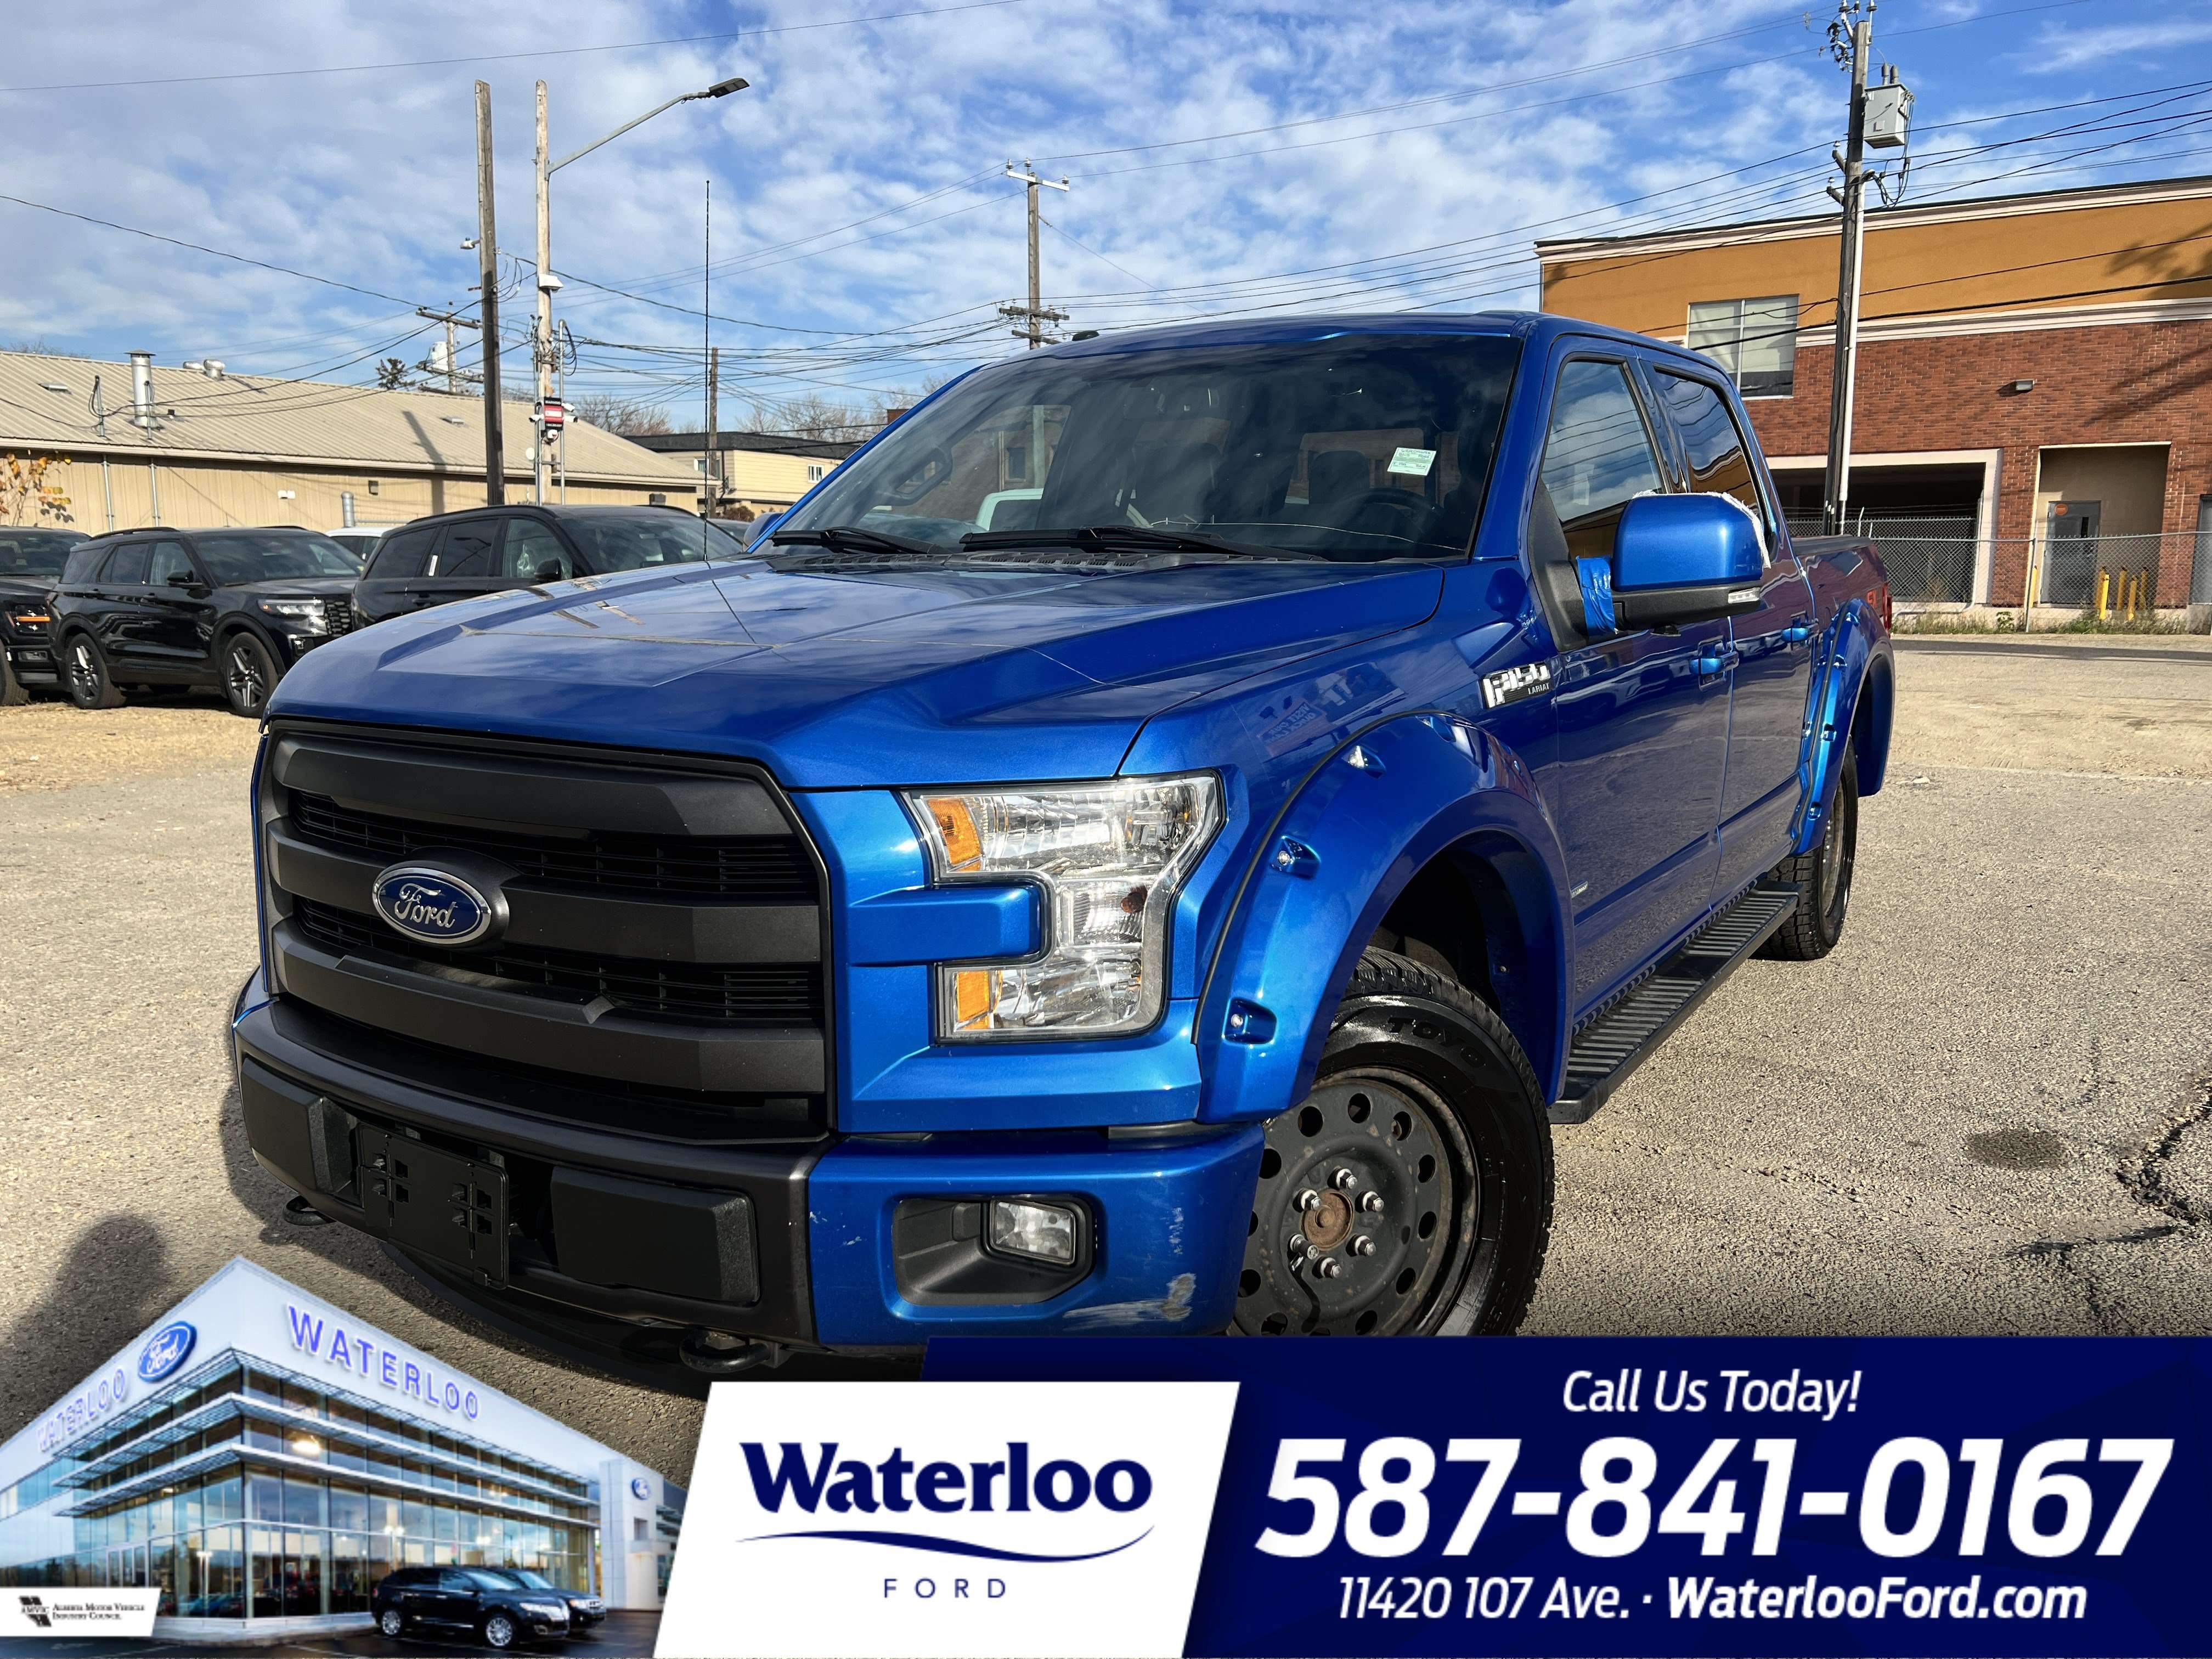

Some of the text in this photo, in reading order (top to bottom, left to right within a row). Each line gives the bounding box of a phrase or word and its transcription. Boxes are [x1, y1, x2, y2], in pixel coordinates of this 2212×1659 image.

[1527, 682, 1550, 695] LARIAT
[394, 883, 458, 928] Ford
[1386, 1017, 1487, 1069] TOYO
